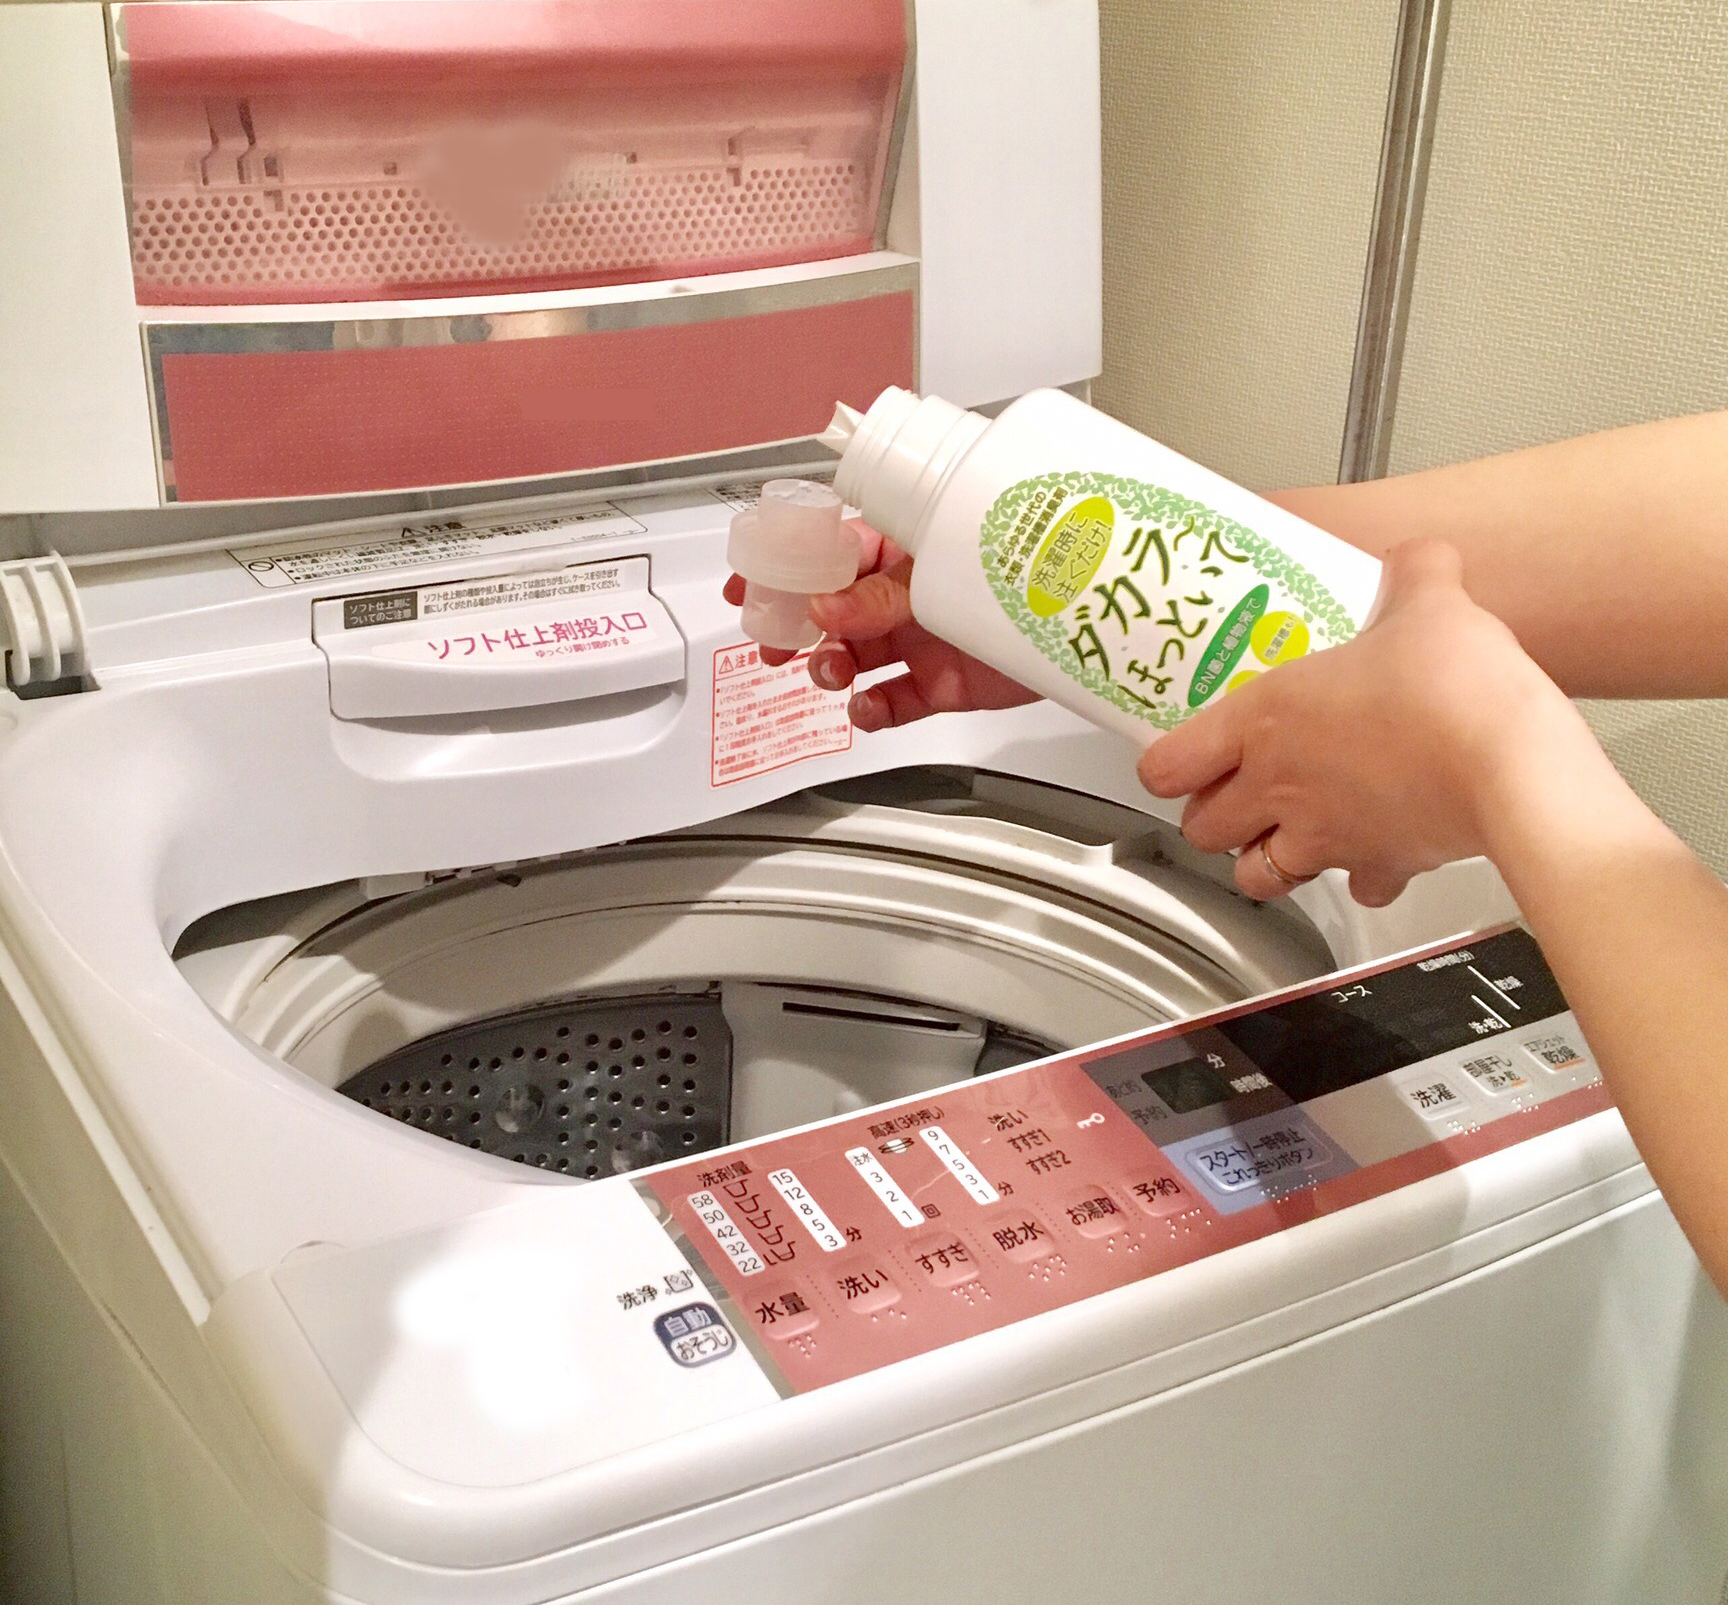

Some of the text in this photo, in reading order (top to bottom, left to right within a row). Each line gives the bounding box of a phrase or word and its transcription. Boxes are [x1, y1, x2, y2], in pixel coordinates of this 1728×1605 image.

[997, 491, 1047, 568] あらゆる世代の
[1031, 511, 1089, 592] 洗濯時に
[1053, 519, 1112, 604] 注ぐだけ!
[1117, 531, 1250, 709] ほっといて
[428, 612, 647, 659] ソフト仕上剤投入口
[535, 636, 630, 658] ゆっくり開け閉めする
[735, 650, 758, 669] 注意
[1331, 985, 1372, 1003] コース
[1207, 1053, 1226, 1069] 分
[1462, 1054, 1513, 1077] 部屋干し
[1541, 1046, 1580, 1066] 乾燥
[1230, 1072, 1273, 1093] 時間後
[1413, 1083, 1457, 1109] 洗濯
[867, 1105, 945, 1140] 高速(3秒押し)
[987, 1109, 1028, 1132] 洗い
[1131, 1106, 1168, 1125] 予約
[927, 1130, 939, 1141] 9
[1007, 1128, 1052, 1153] すすぎ1
[939, 1143, 951, 1155] 7
[852, 1151, 873, 1167] 注水
[952, 1159, 965, 1171] 5
[1026, 1150, 1072, 1175] すすぎ2
[697, 1160, 752, 1187] 洗剤量
[772, 1172, 793, 1186] 15
[870, 1171, 883, 1183] 3
[965, 1174, 978, 1186] 3
[784, 1187, 806, 1201] 12
[886, 1190, 899, 1203] 2
[978, 1189, 989, 1200] 1
[998, 1181, 1014, 1196] 分
[1133, 1177, 1181, 1203] 予約
[691, 1194, 714, 1209] 58
[800, 1203, 814, 1215] 8
[921, 1203, 941, 1219] 回
[703, 1209, 725, 1224] 50
[901, 1210, 913, 1221] 1
[1066, 1197, 1120, 1226] お湯取
[716, 1225, 738, 1239] 42
[812, 1219, 825, 1231] 5
[846, 1226, 862, 1242] 分
[824, 1234, 838, 1247] 3
[992, 1221, 1044, 1251] 脱水
[726, 1241, 749, 1256] 32
[915, 1242, 969, 1274] すすぎ
[738, 1257, 762, 1273] 22
[837, 1269, 889, 1299] 洗い
[617, 1284, 658, 1310] 洗浄
[755, 1292, 811, 1324] 水量
[663, 1307, 712, 1337] 自動
[676, 1329, 729, 1361] おそうじ
